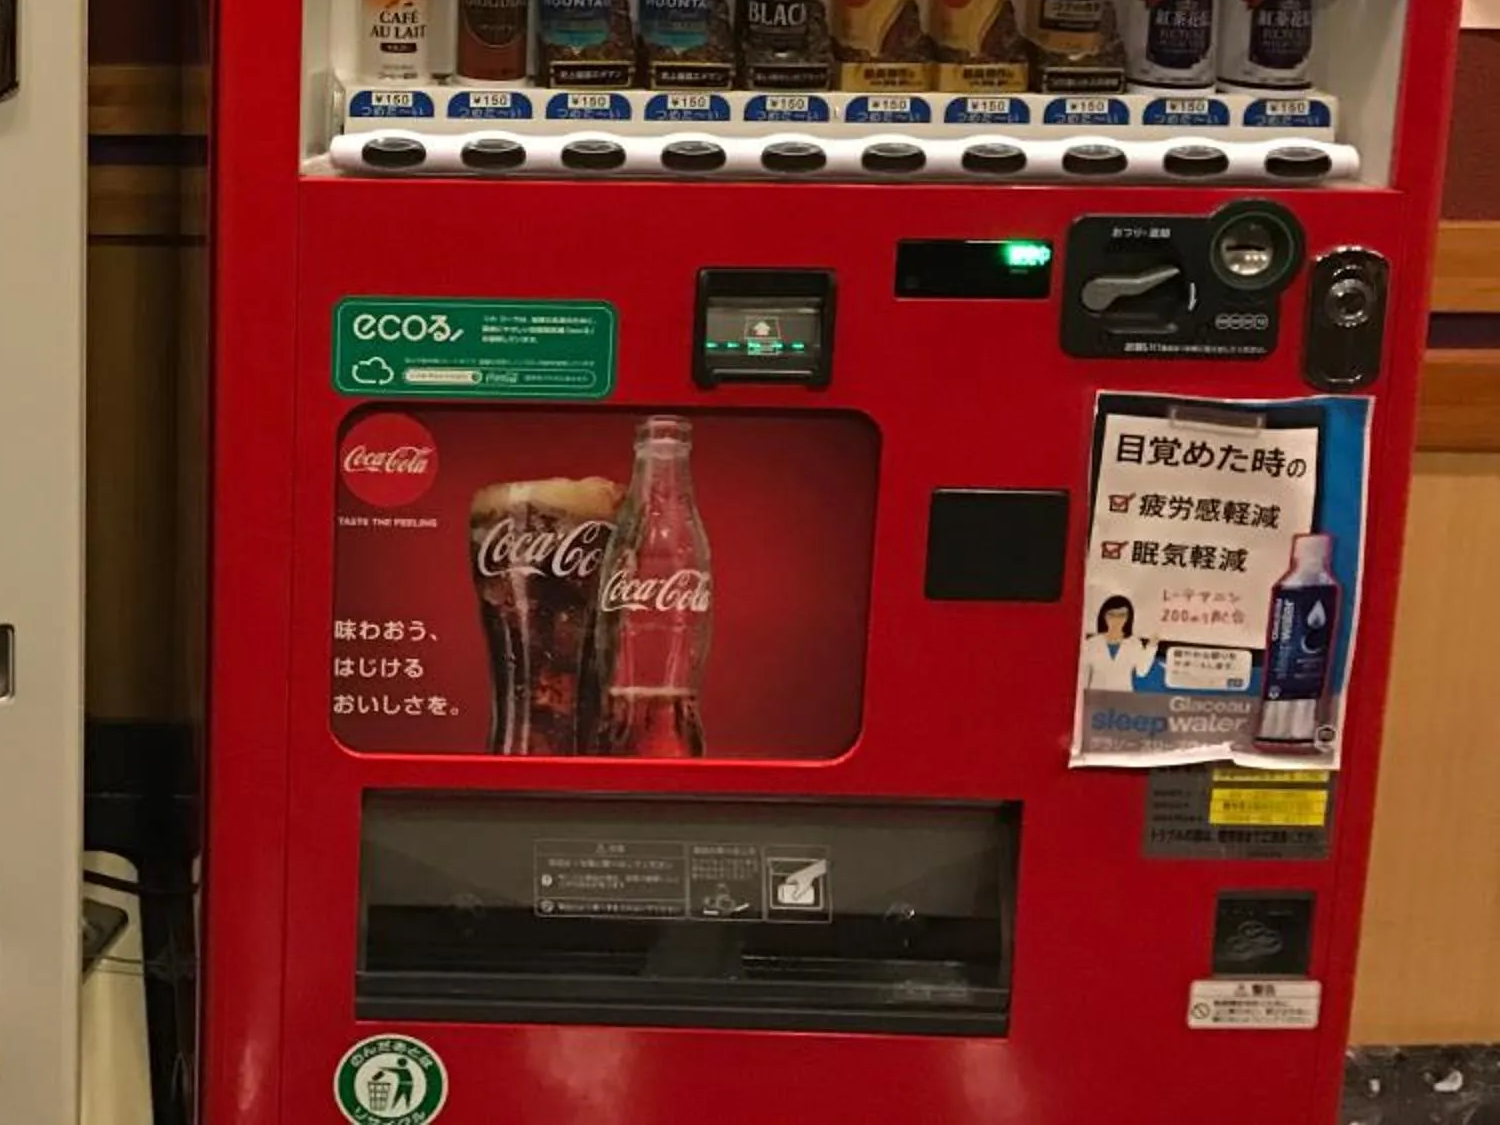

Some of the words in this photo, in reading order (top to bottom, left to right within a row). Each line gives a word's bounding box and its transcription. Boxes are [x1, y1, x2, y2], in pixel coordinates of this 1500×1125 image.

[380, 7, 419, 24] CAFÉ
[370, 25, 390, 38] AU
[344, 444, 434, 475] Coca-Cola
[1116, 434, 1307, 479] 目覚めた時の
[1139, 493, 1281, 529] 疲労感軽減
[477, 520, 604, 577] Coca-Co
[1131, 540, 1249, 572] 眠気軽減
[334, 620, 440, 642] 味わおう、
[333, 657, 425, 679] はじける
[332, 695, 461, 717] おいしさを。
